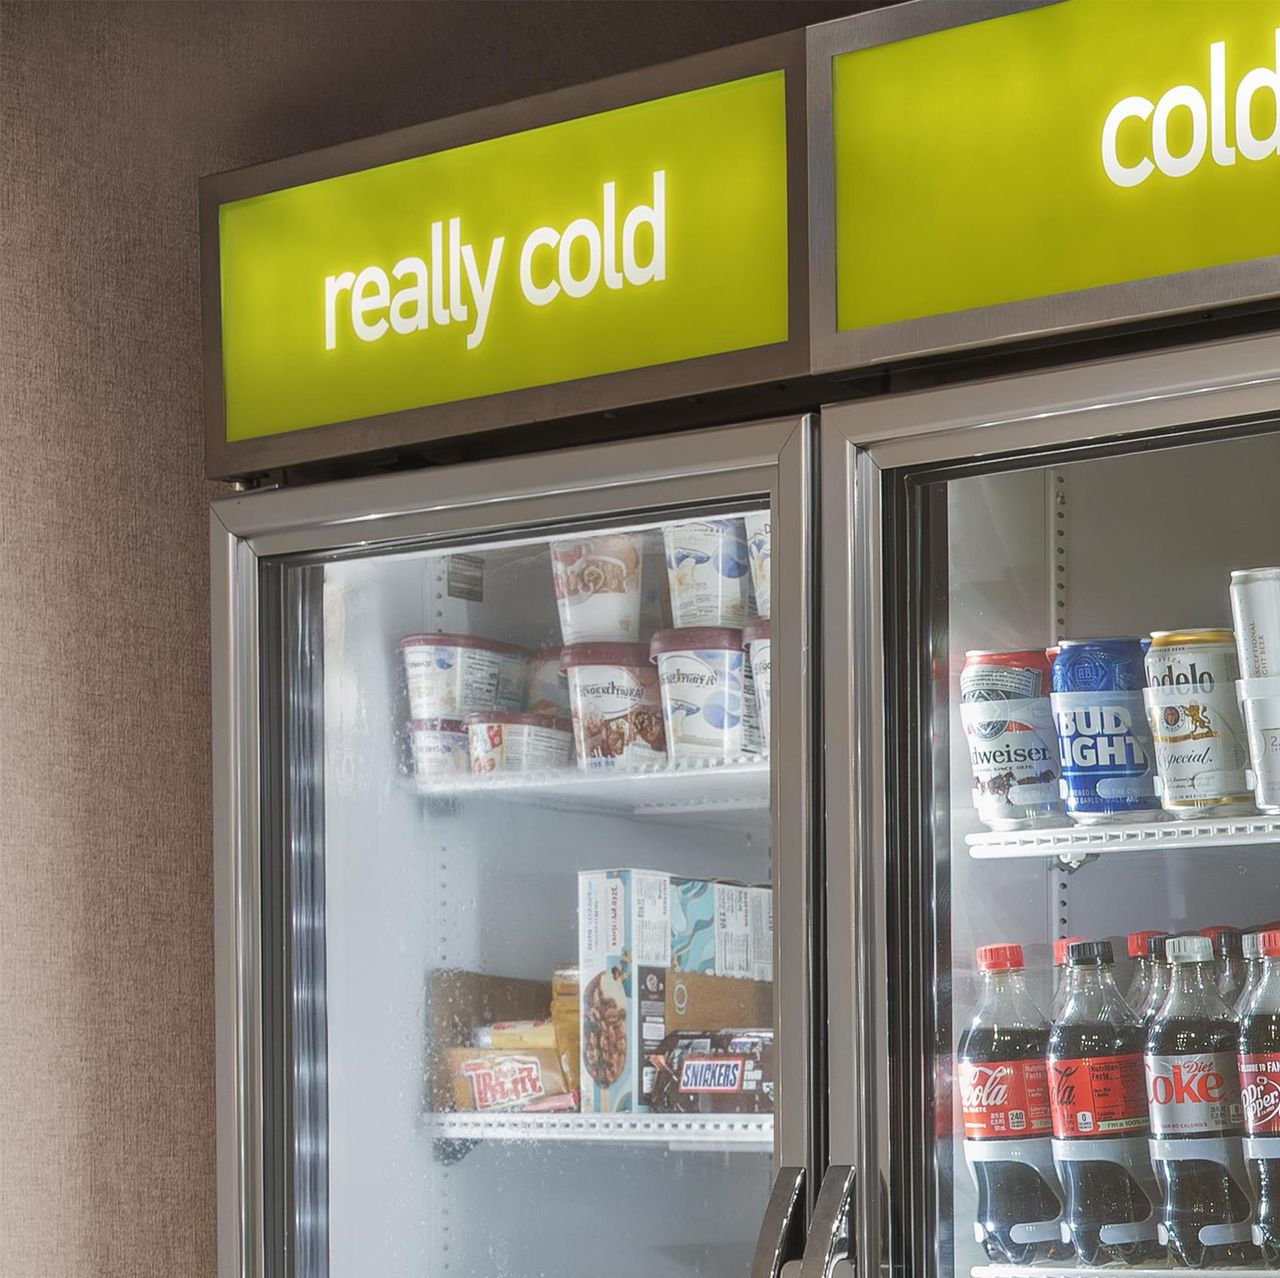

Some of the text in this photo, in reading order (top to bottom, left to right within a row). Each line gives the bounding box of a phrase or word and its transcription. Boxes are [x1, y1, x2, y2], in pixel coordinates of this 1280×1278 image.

[324, 170, 666, 350] really cold
[1057, 707, 1131, 737] BUD
[1060, 736, 1145, 767] LIGHT
[1185, 1061, 1213, 1073] Diet
[1009, 1112, 1023, 1121] 240
